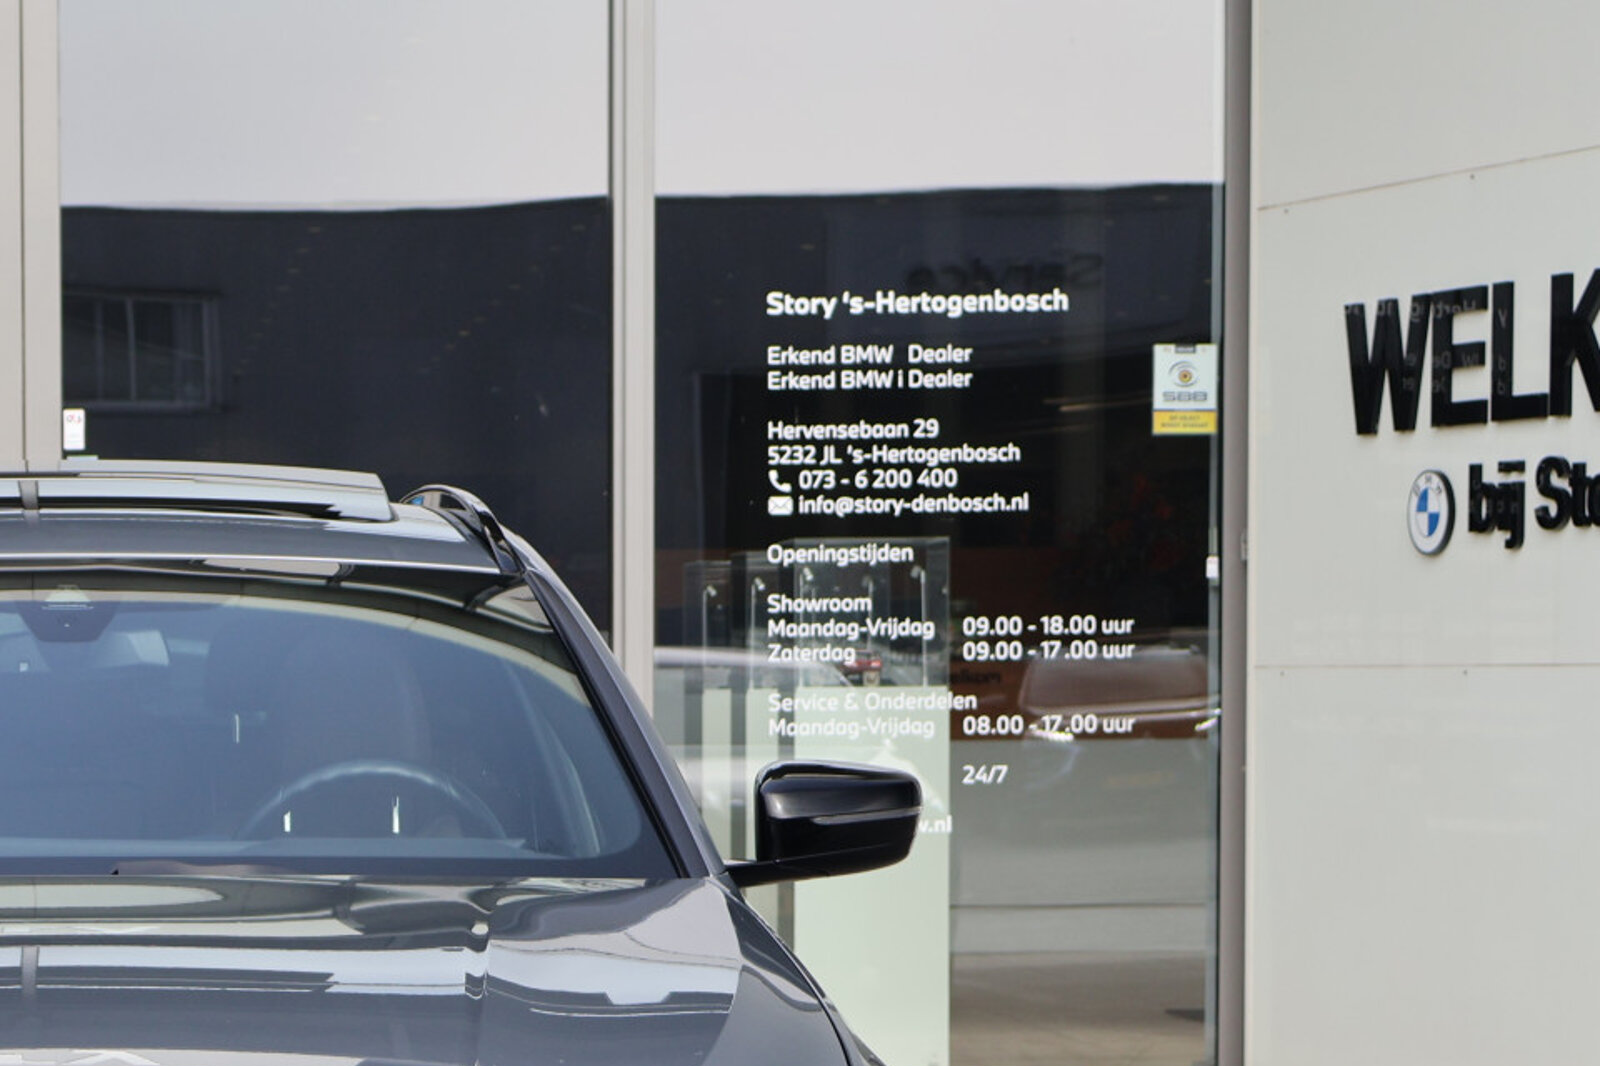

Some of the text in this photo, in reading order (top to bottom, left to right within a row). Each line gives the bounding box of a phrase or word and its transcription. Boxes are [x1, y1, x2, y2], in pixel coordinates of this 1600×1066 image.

[767, 291, 837, 319] Story
[767, 343, 973, 365] Erkend BMW Dealer
[767, 368, 973, 390] Erkend BMW i Dealer
[768, 419, 939, 440] Hervensebaan 29
[768, 446, 816, 465] 5232
[820, 445, 842, 466] JL
[799, 470, 835, 490] 073
[855, 470, 867, 489] 6
[871, 469, 912, 489] 200
[917, 468, 957, 488] 400
[799, 492, 1029, 518] info@story-denbosch.nl
[1469, 461, 1526, 549] bij
[767, 543, 914, 566] Openingstijden
[767, 594, 872, 613] Showroom
[768, 618, 935, 640] Maandag-Vrijdag
[962, 617, 1023, 636] 09.00
[1040, 616, 1097, 636] 18.00
[1102, 619, 1135, 635] uur
[768, 643, 856, 664] Zaterdag
[962, 642, 1023, 661] 09.00
[1102, 644, 1135, 660] uur
[769, 691, 977, 713] Service & Onderdelen
[769, 717, 935, 740] Maandag-Vrijdag
[962, 716, 1024, 736] 08.00
[1102, 718, 1135, 734] uur
[962, 765, 1008, 785] 24/7
